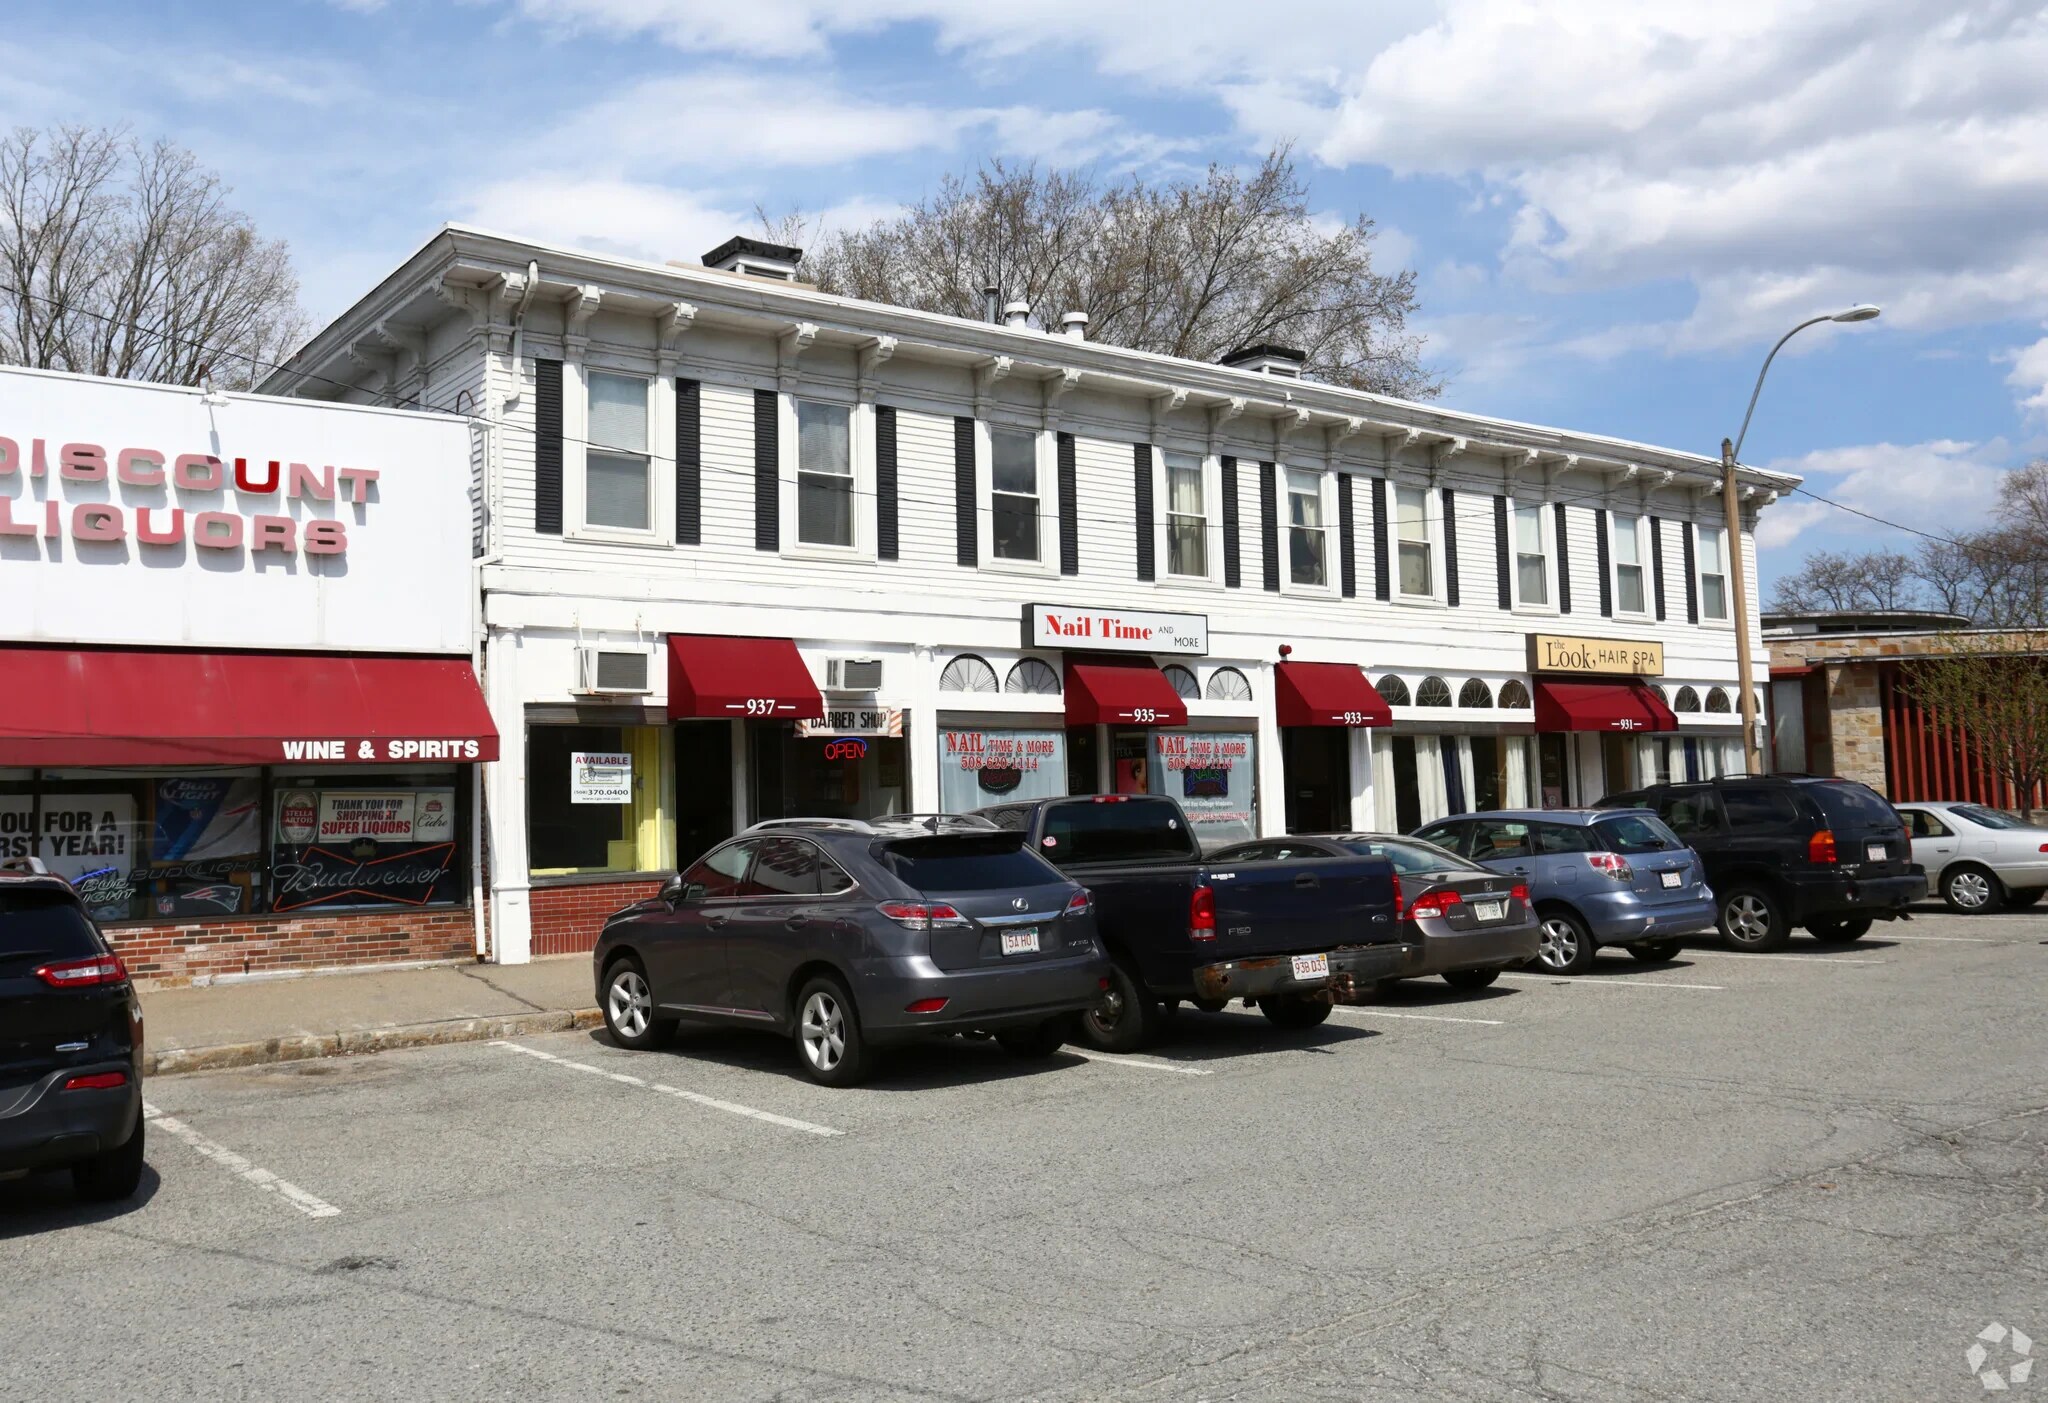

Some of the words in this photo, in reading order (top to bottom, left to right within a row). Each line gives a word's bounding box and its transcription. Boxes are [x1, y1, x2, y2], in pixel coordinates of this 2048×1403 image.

[0, 495, 348, 554] LIQUORS
[1045, 615, 1091, 637] Nail
[1098, 618, 1153, 641] Time
[1158, 626, 1174, 634] AND
[1174, 637, 1199, 648] MORE
[1554, 639, 1565, 649] the
[1598, 649, 1628, 664] HAIR
[1633, 651, 1656, 666] SPA
[811, 711, 855, 728] BARBER
[860, 712, 886, 728] SHOP
[282, 740, 346, 759] WINE
[357, 740, 376, 759] &
[388, 740, 479, 759] SPIRITS
[946, 731, 986, 752] NAIL
[989, 739, 1013, 752] TIME
[1016, 740, 1023, 752] &
[1027, 740, 1055, 753] MORE
[1156, 735, 1189, 754] NAIL
[1191, 742, 1212, 754] TIME
[1214, 742, 1221, 754] &
[1223, 742, 1247, 754] MORE
[824, 743, 865, 760] OPEN
[575, 756, 628, 765] AVAILABLE
[961, 756, 1039, 769] 508-620-1114
[1168, 757, 1233, 769] 508-620-1114
[332, 799, 363, 810] THANK
[365, 799, 384, 810] YOU
[385, 800, 403, 810] FOR
[0, 811, 34, 833] OU
[44, 811, 93, 833] FOR
[100, 811, 117, 832] A
[336, 810, 384, 821] SHOPPING
[386, 810, 397, 820] AT
[417, 813, 448, 828] Cidre
[321, 821, 359, 835] SUPER
[361, 820, 411, 835] LIQUORS
[50, 835, 124, 857] YEAR!
[130, 868, 183, 882] BUD
[194, 860, 260, 876] LIGHT
[272, 860, 449, 893] Budweiser
[81, 878, 129, 891] BUD
[1228, 926, 1252, 935] F150
